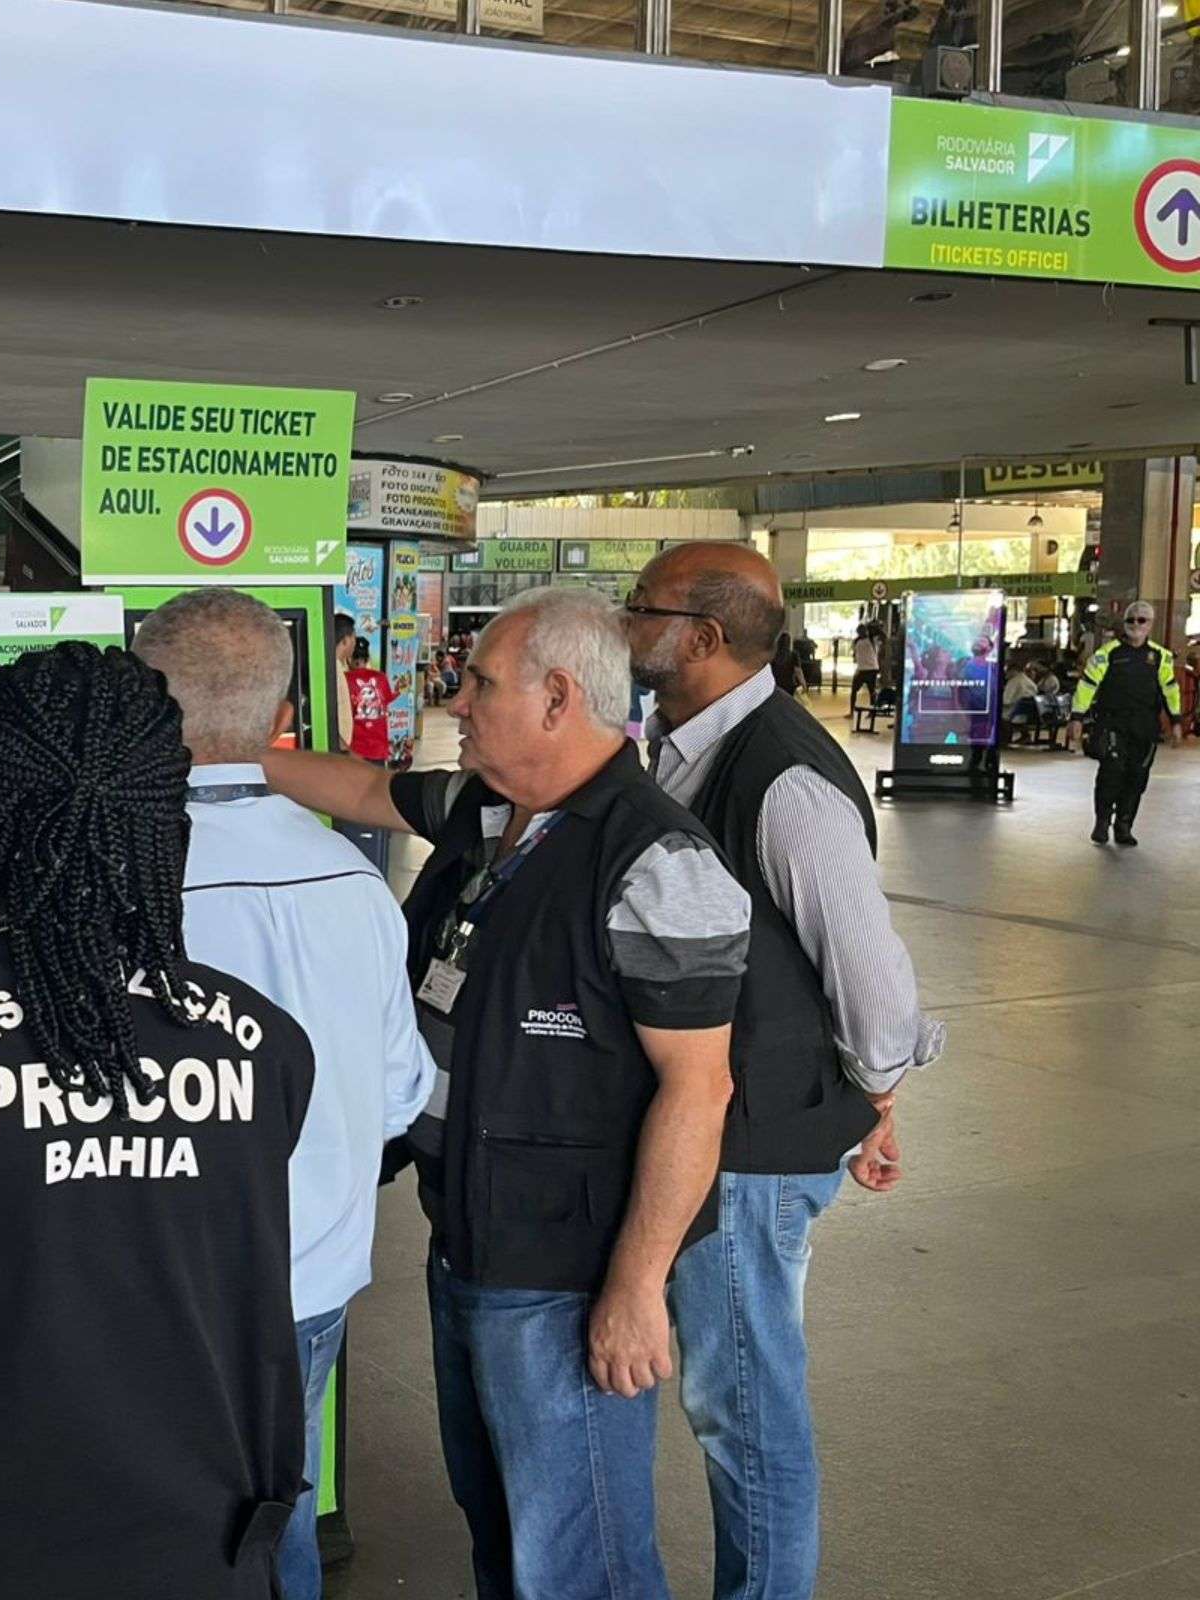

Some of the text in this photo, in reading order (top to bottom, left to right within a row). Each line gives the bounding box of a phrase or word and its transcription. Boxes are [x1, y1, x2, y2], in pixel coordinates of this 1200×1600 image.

[936, 133, 1016, 156] RODOVIÁRIA
[945, 155, 1015, 176] SALVADOR
[911, 196, 1091, 238] BILHETERIAS
[930, 243, 1069, 272] (TICKETS OFFICE)
[103, 402, 316, 437] VALIDE SEU TICKET
[101, 445, 337, 477] DE ESTACIONAMENTO
[990, 460, 1104, 481] DESEM
[381, 481, 408, 491] FOTO
[99, 488, 161, 514] AQUI.
[386, 493, 411, 504] FOTO
[528, 1009, 582, 1026] PROCON
[46, 1136, 200, 1184] BAHIA
